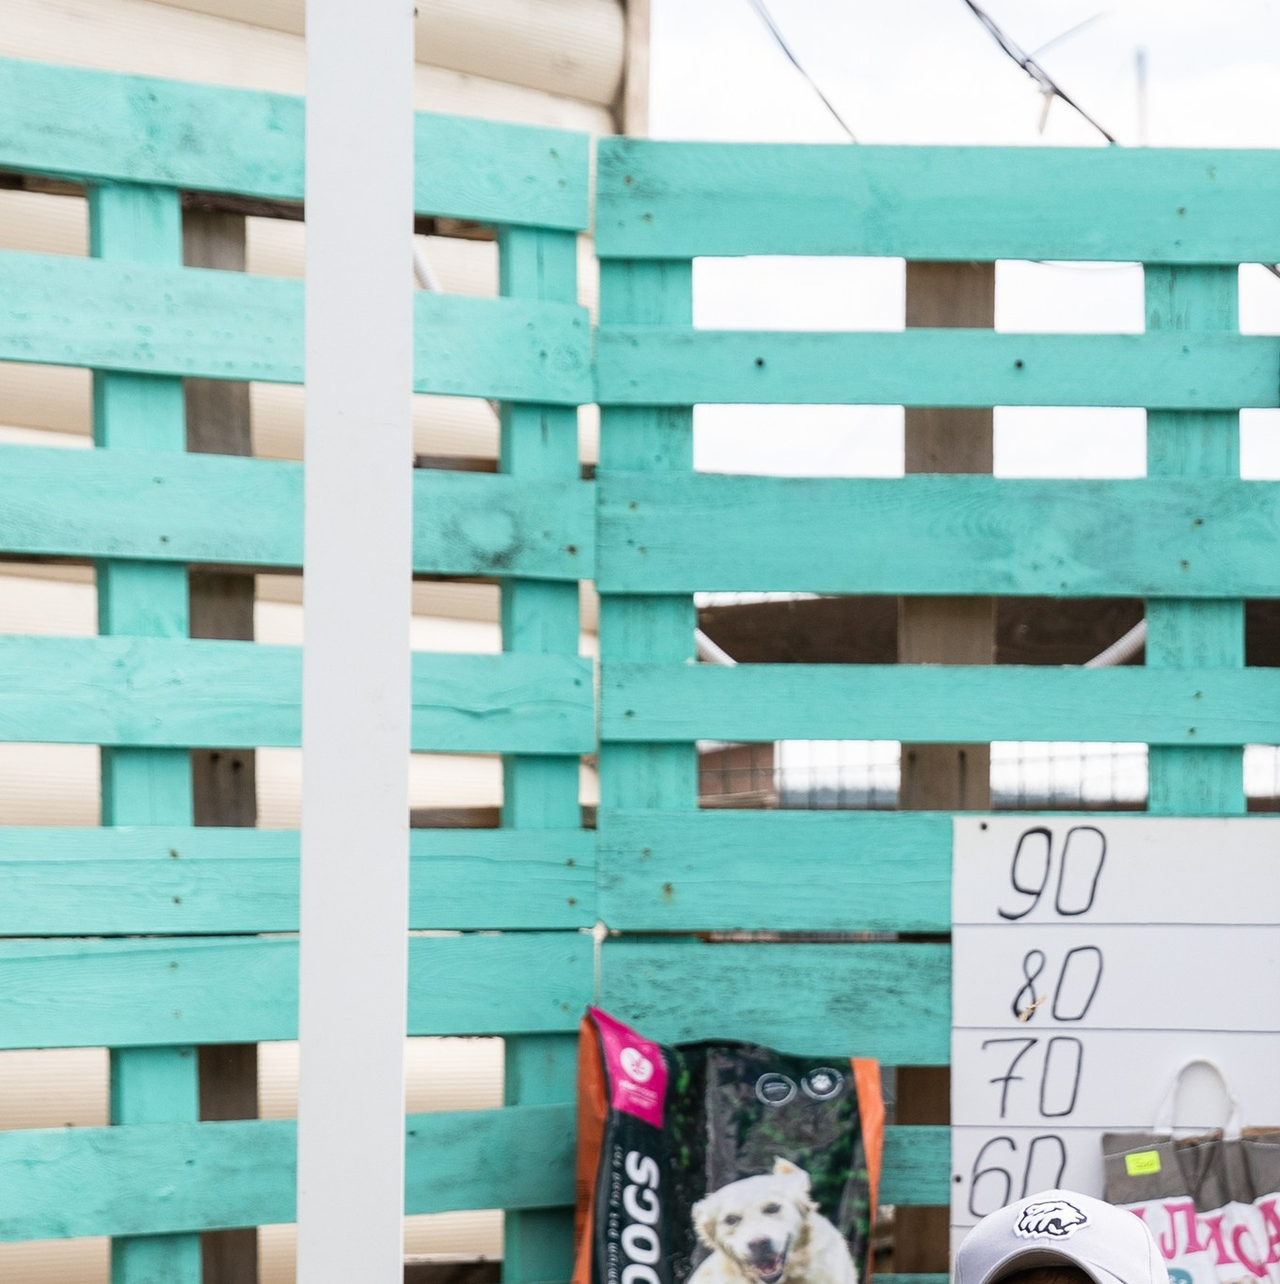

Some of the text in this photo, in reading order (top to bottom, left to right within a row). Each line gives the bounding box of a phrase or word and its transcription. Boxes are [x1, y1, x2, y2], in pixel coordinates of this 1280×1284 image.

[998, 826, 1107, 920] 90
[1012, 945, 1103, 1022] 80
[982, 1036, 1083, 1118] 70
[969, 1135, 1066, 1218] 60
